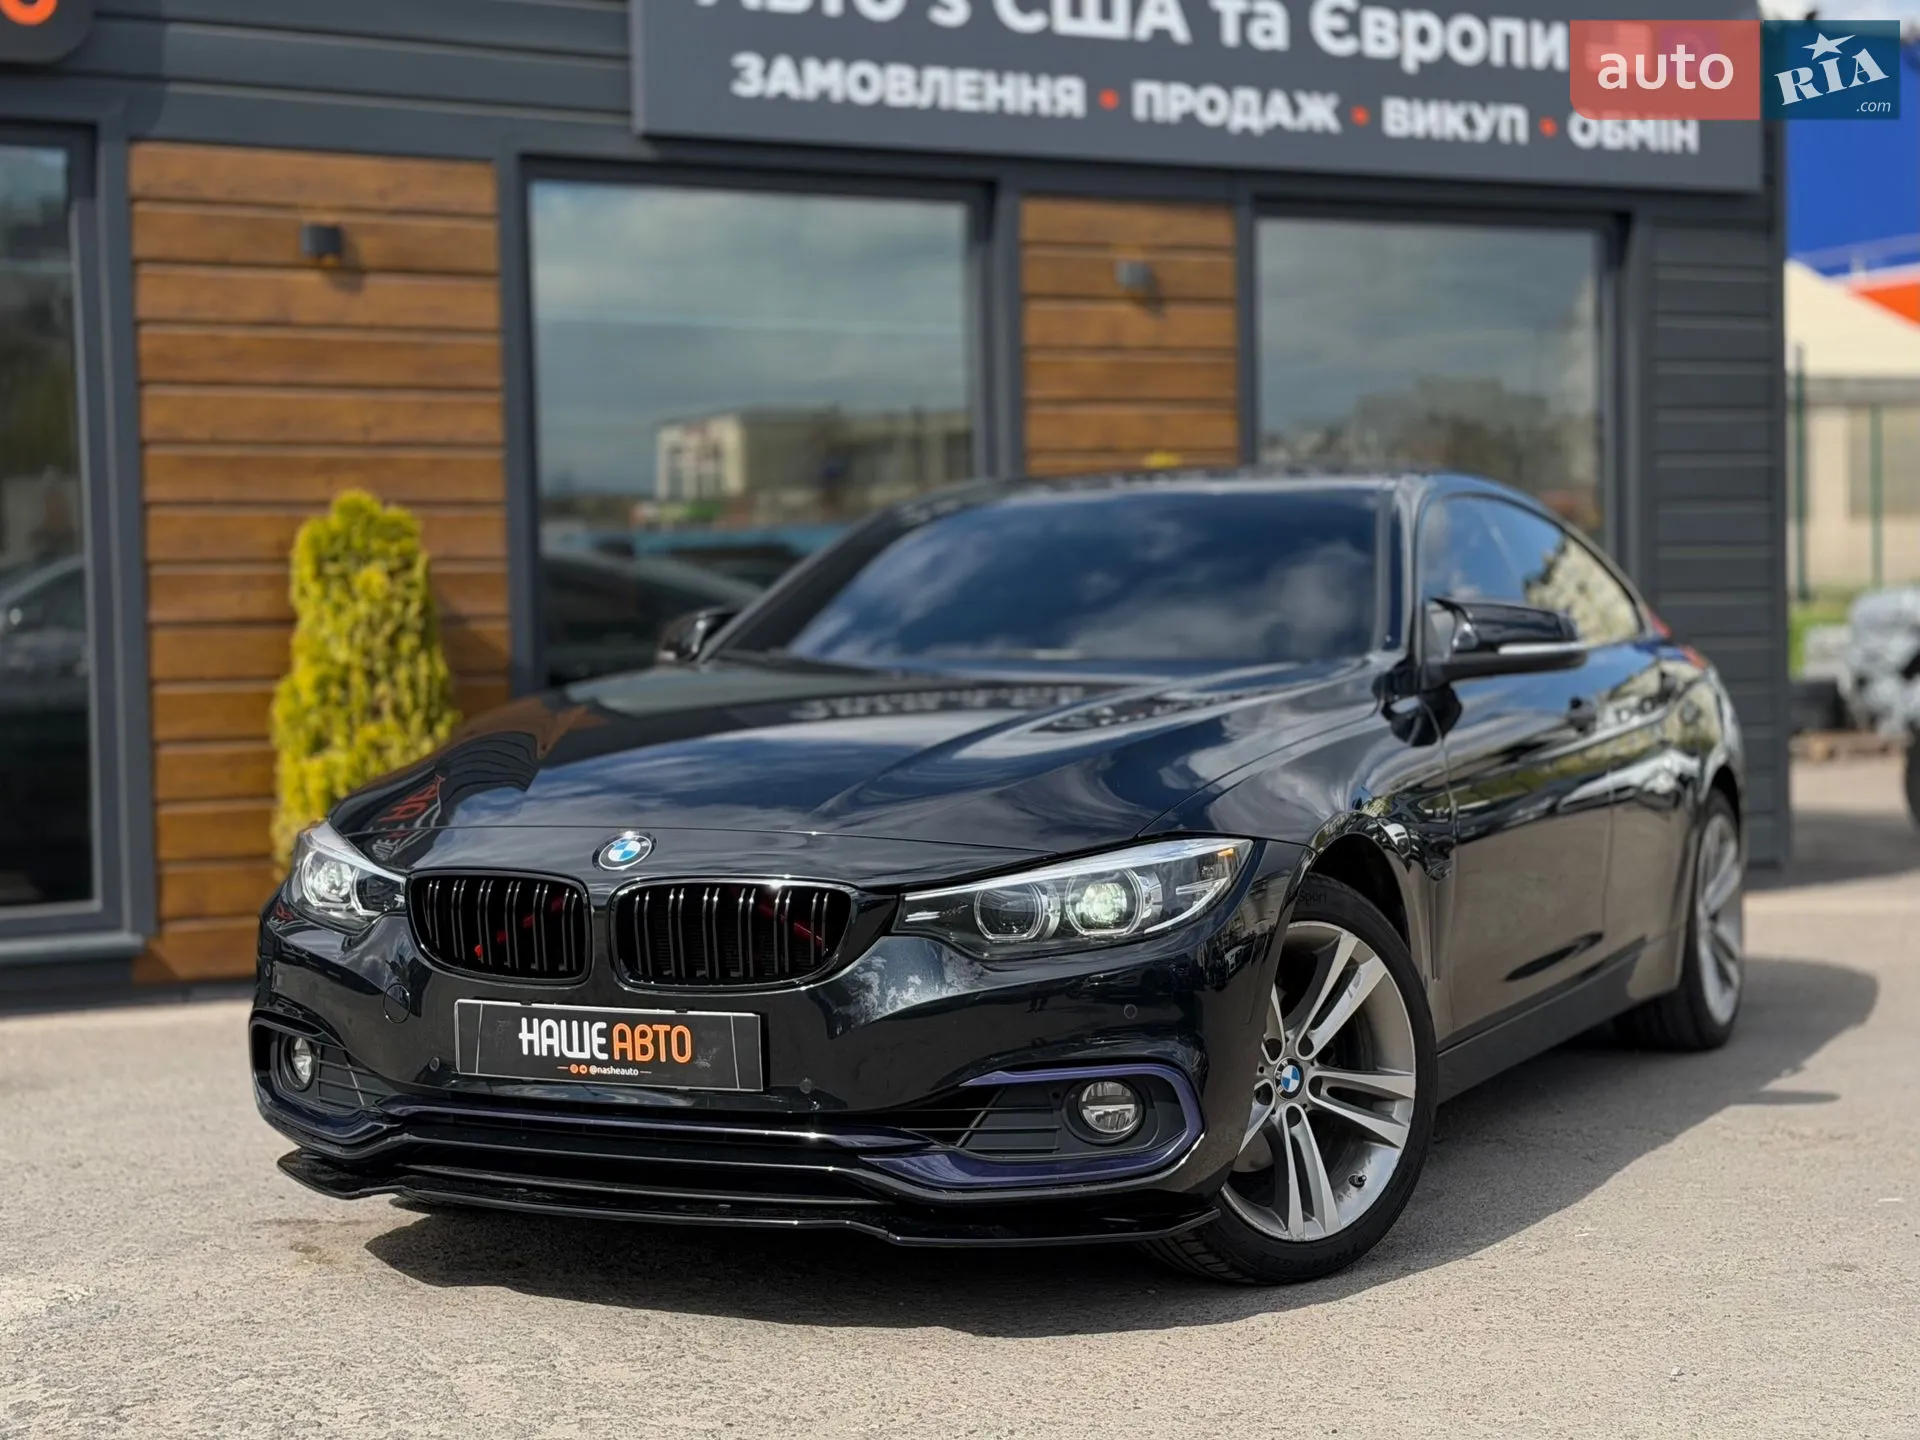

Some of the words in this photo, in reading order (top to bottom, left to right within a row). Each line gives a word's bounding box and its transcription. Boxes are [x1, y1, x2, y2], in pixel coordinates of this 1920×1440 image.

[1309, 0, 1570, 75] Європи
[729, 50, 1087, 119] ЗАМОВЛЕННЯ
[1131, 79, 1343, 136] ПРОДАЖ
[1381, 95, 1529, 145] ВИКУП
[1566, 107, 1700, 154] ОБМІН
[518, 1017, 609, 1060] НАШЕ
[612, 1022, 692, 1063] АВТО
[589, 1064, 639, 1076] @nasheauto
